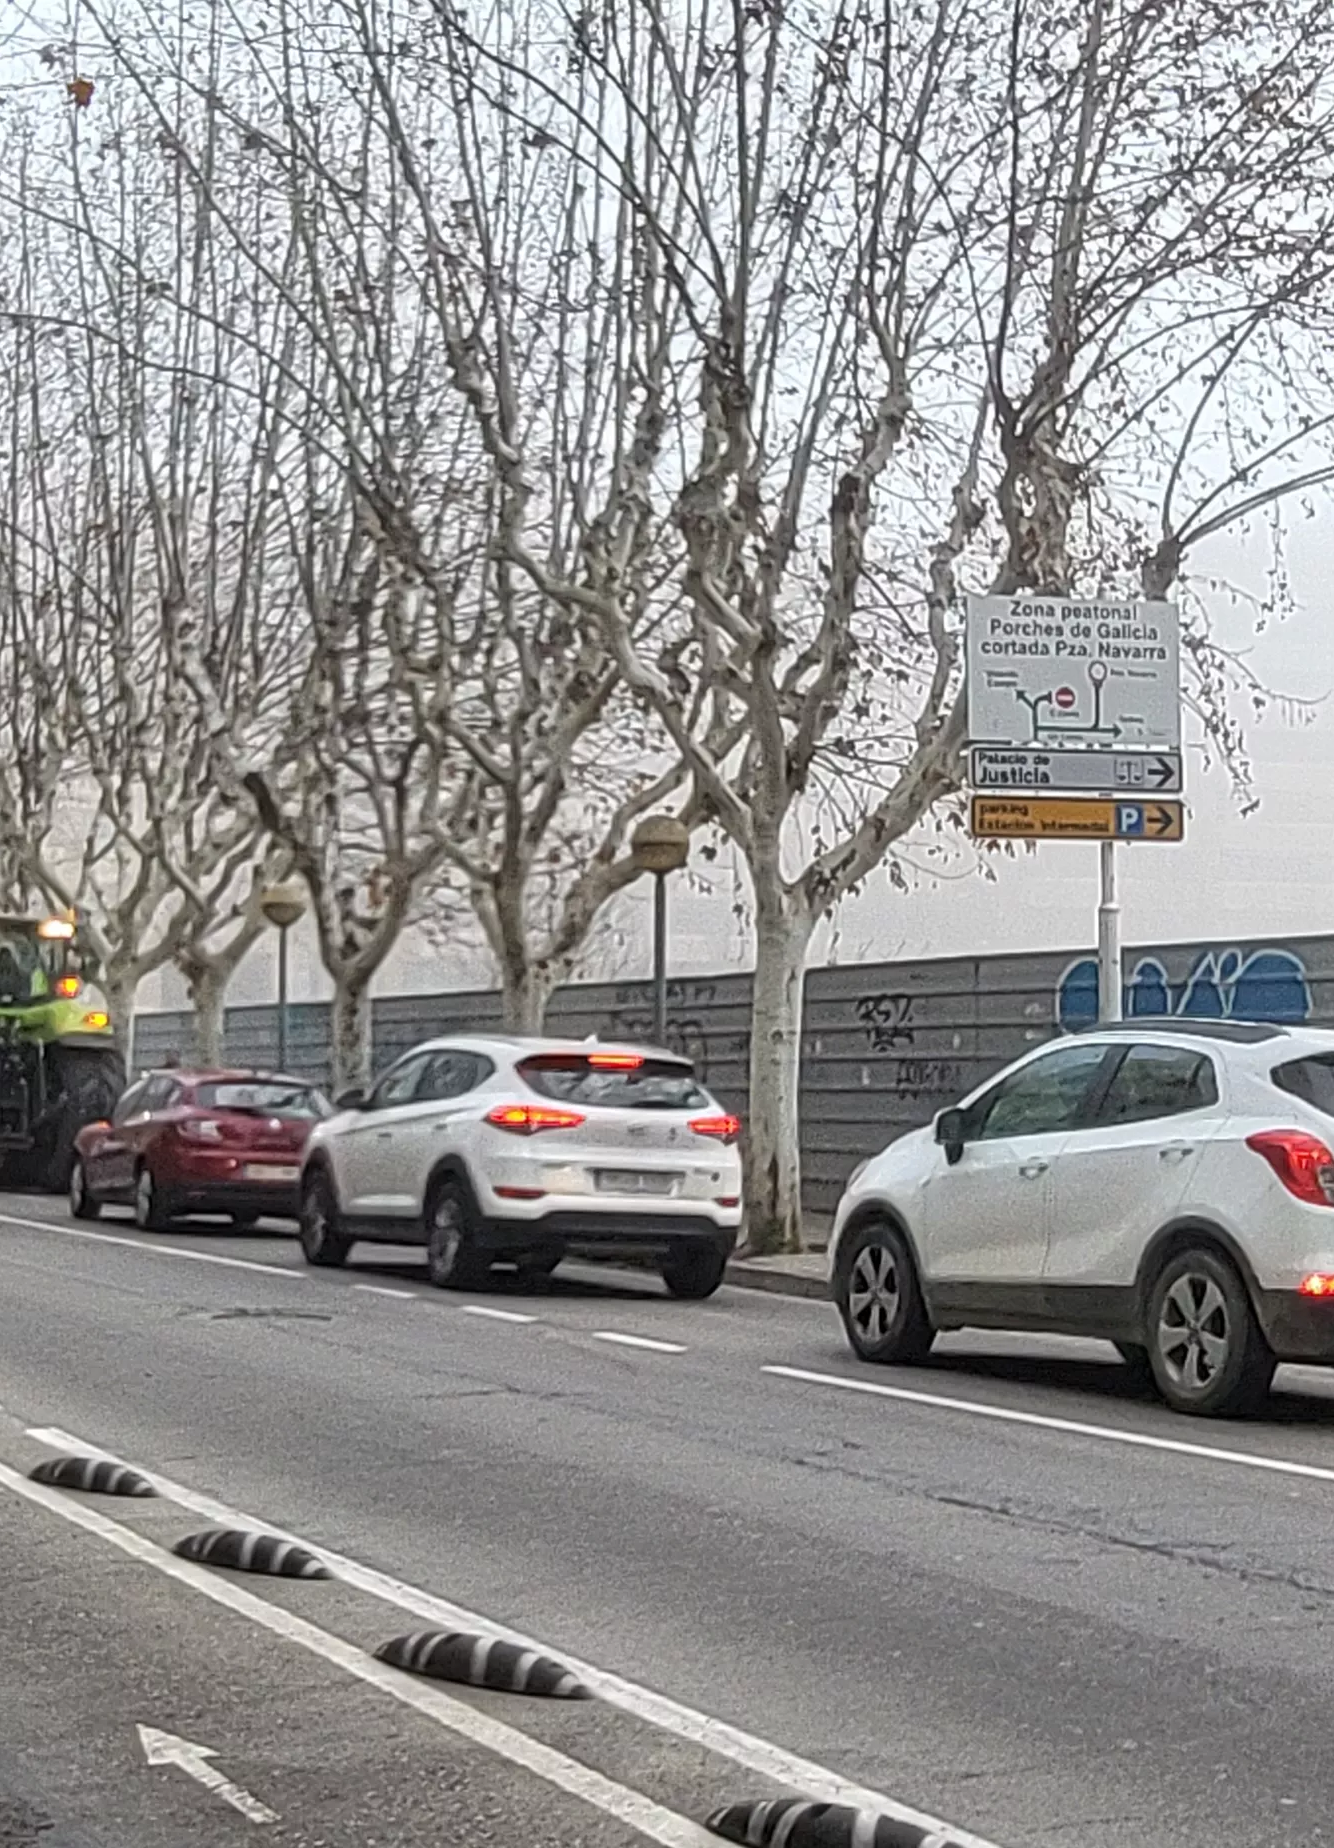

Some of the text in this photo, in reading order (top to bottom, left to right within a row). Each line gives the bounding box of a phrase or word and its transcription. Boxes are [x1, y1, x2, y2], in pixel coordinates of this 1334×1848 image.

[1010, 600, 1137, 621] Zona peatonal
[990, 618, 1158, 640] Porches de Galicia
[981, 640, 1167, 660] cortada Pza. Navarra
[979, 752, 1050, 765] Palacio de
[979, 767, 1051, 784] Justicia
[980, 803, 1029, 817] parking
